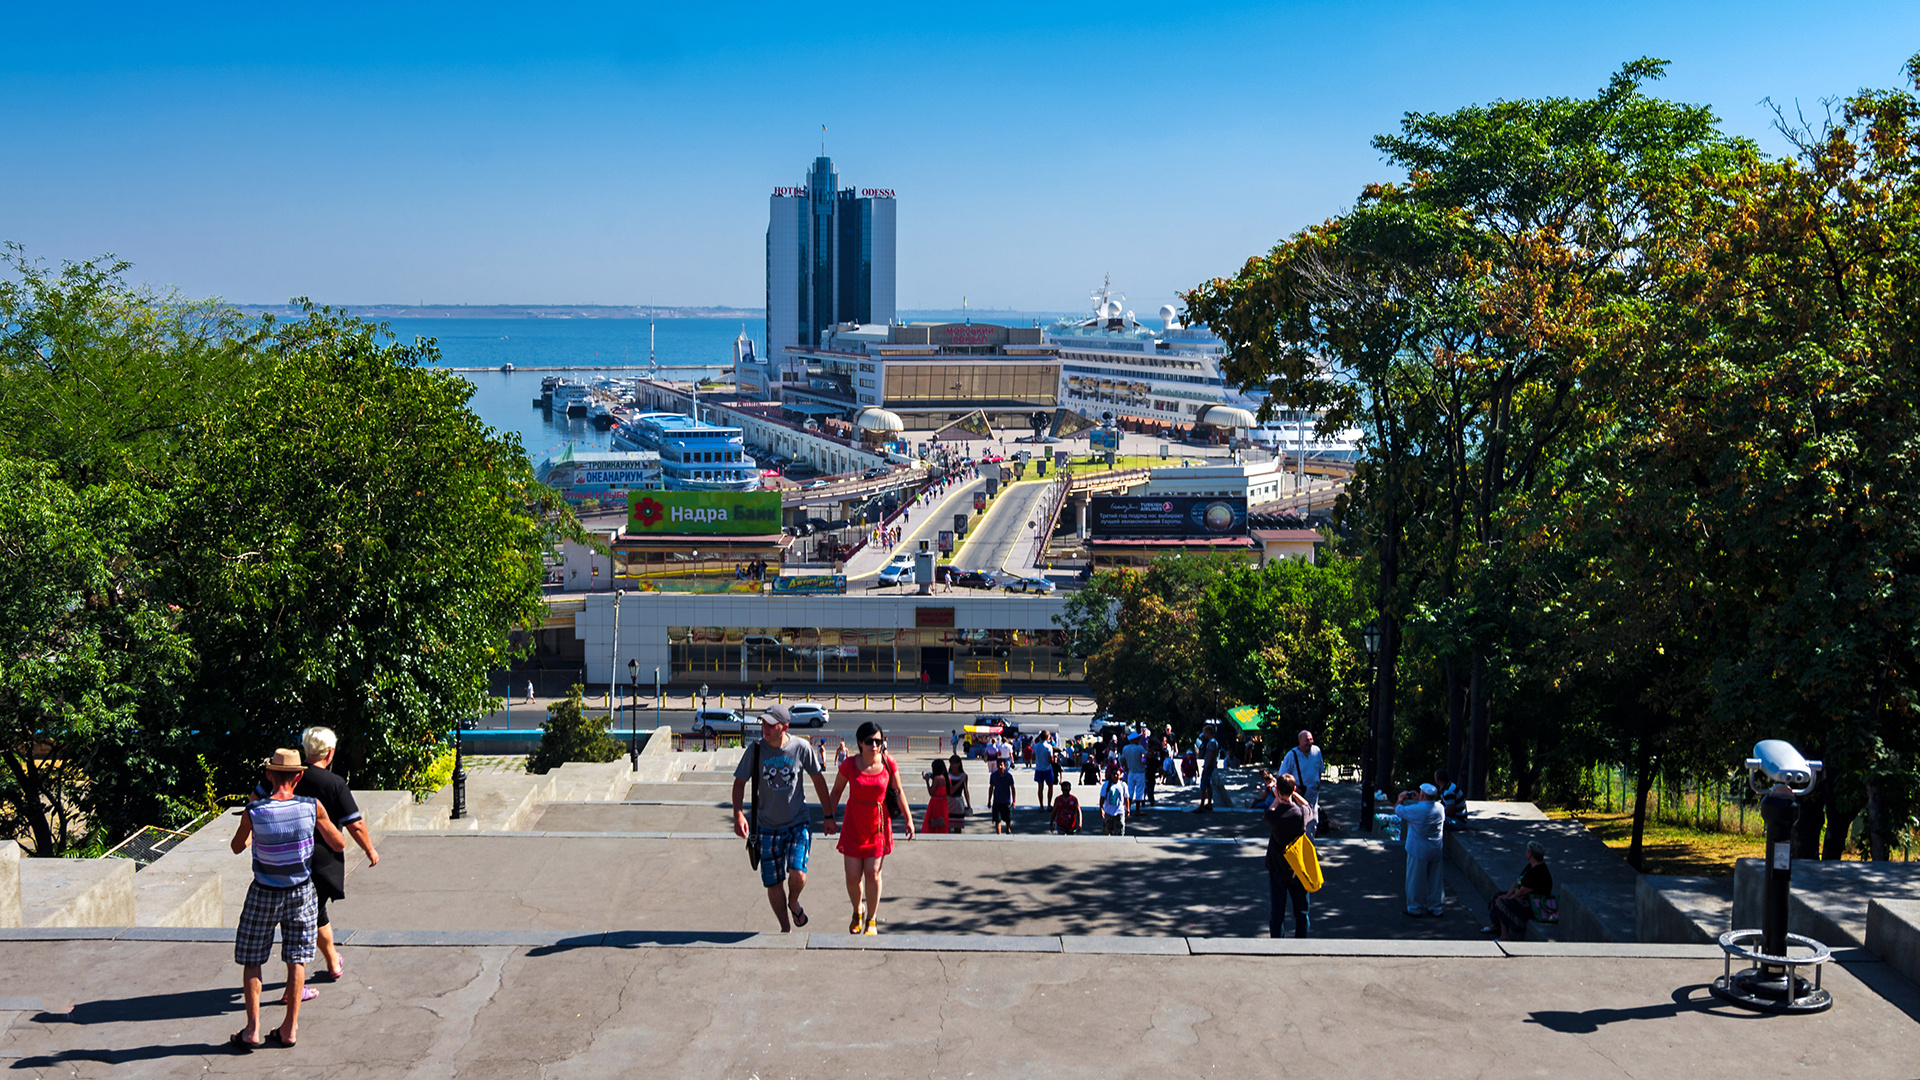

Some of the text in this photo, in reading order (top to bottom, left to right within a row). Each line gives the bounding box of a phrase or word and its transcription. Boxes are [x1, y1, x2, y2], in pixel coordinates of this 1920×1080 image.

[774, 186, 896, 196] HOTEL ODESSA
[952, 335, 988, 343] ВОКЗАЛ
[588, 461, 641, 469] ТРОПИКАРИУМ
[586, 471, 643, 483] ОКЕАНАРИУМ
[562, 491, 593, 499] ОТНЫЕ
[595, 491, 601, 499] И
[671, 505, 776, 523] Надра Банк
